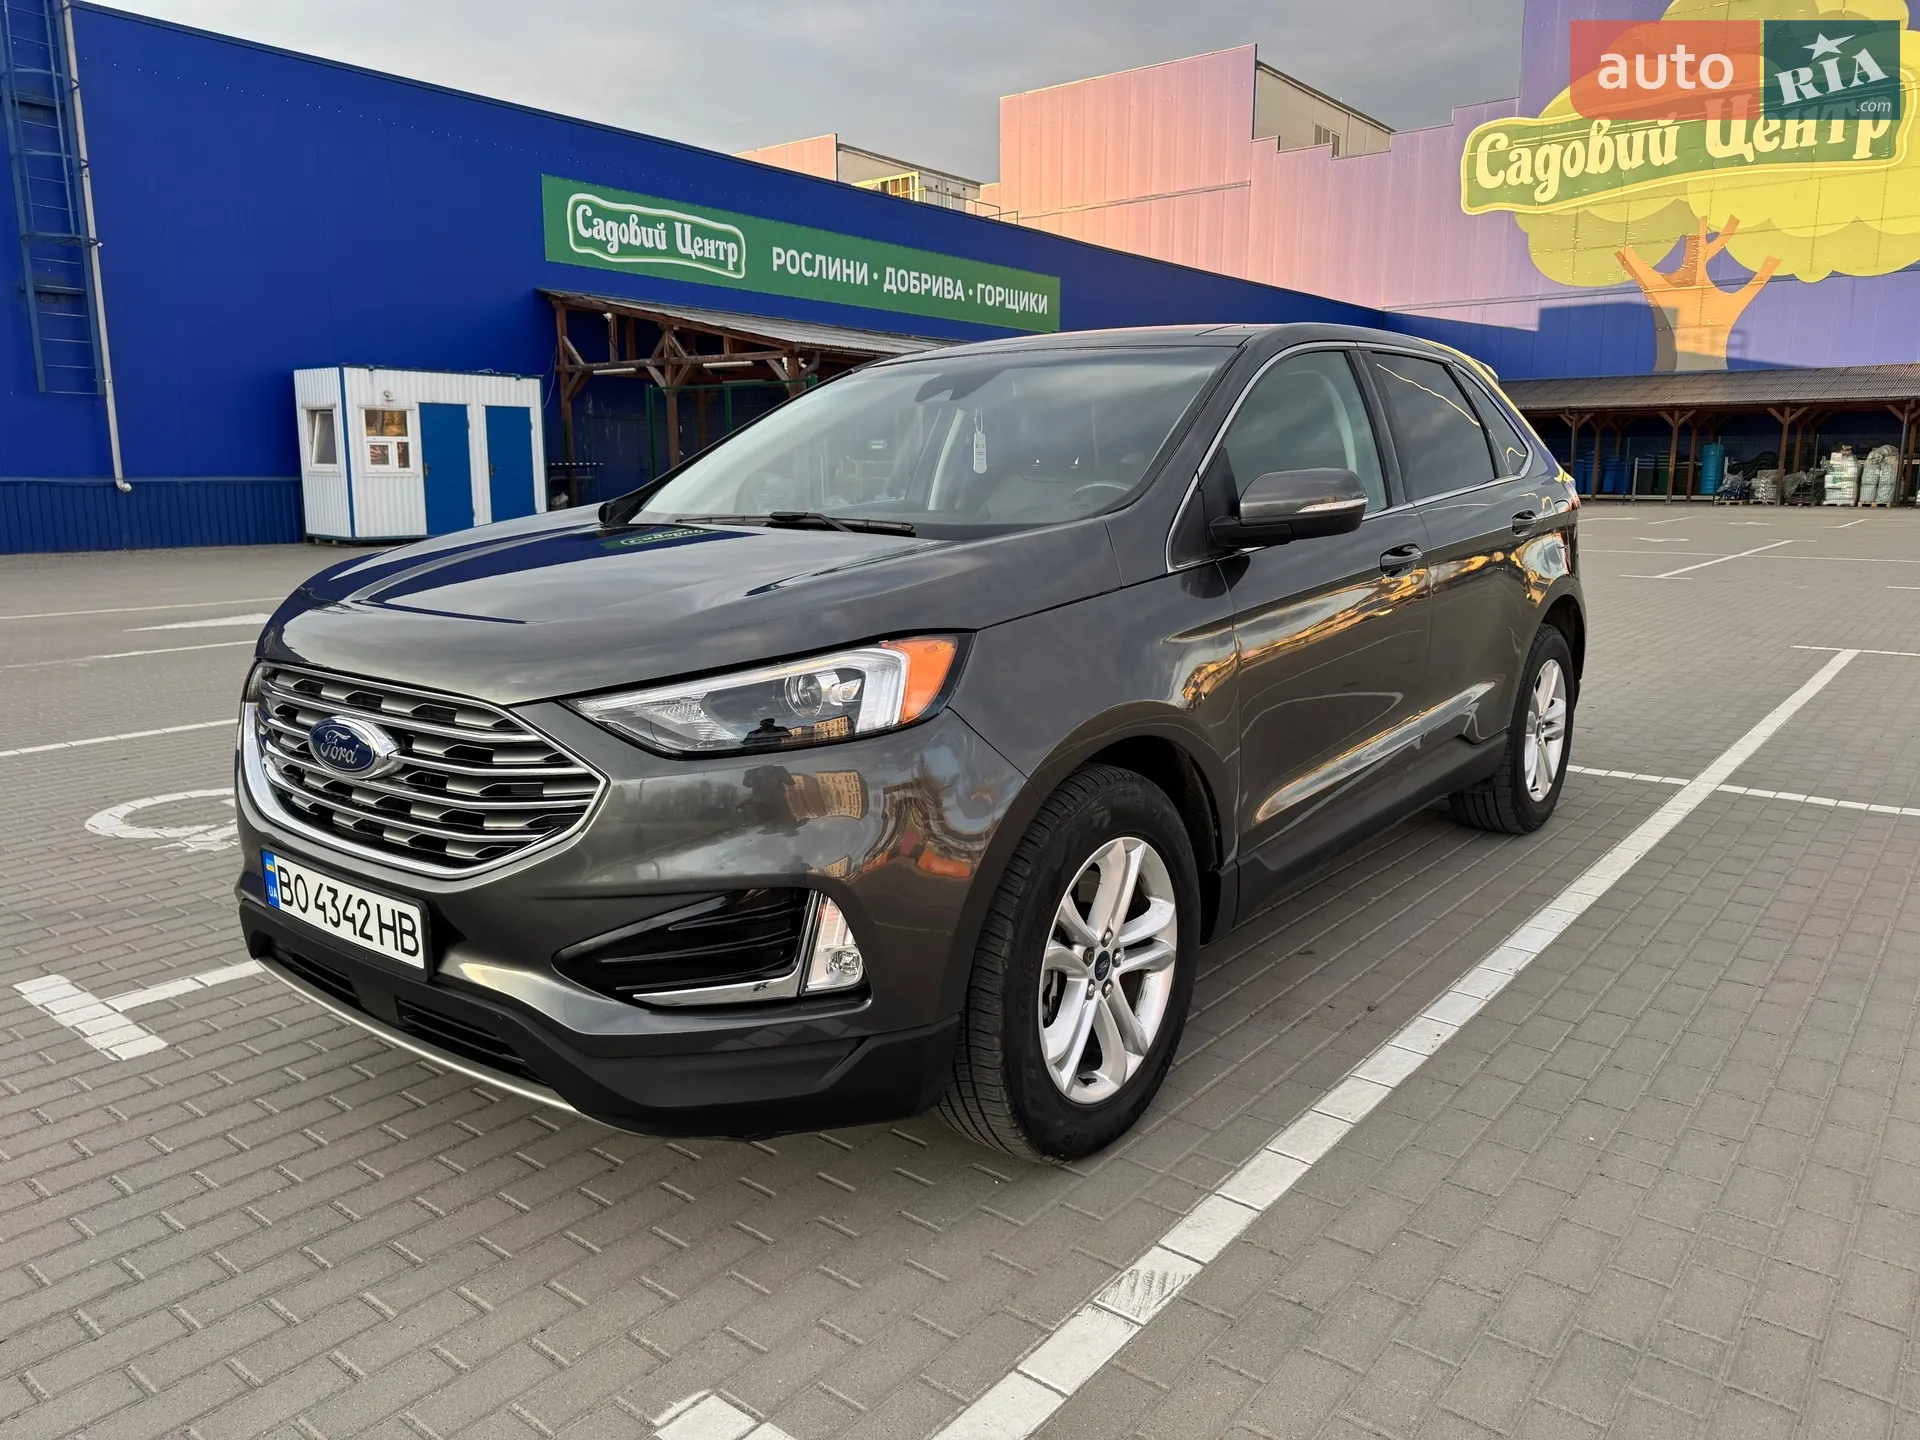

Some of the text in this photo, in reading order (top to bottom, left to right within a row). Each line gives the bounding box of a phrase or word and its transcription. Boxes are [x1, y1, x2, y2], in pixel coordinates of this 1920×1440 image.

[1475, 94, 1893, 203] Садовий Центр
[575, 203, 739, 271] Садовий Центр
[771, 246, 1048, 315] РОСЛИНИ ДОБРИВА ГОРЩИКИ
[319, 729, 359, 765] Ford
[268, 885, 278, 899] UA
